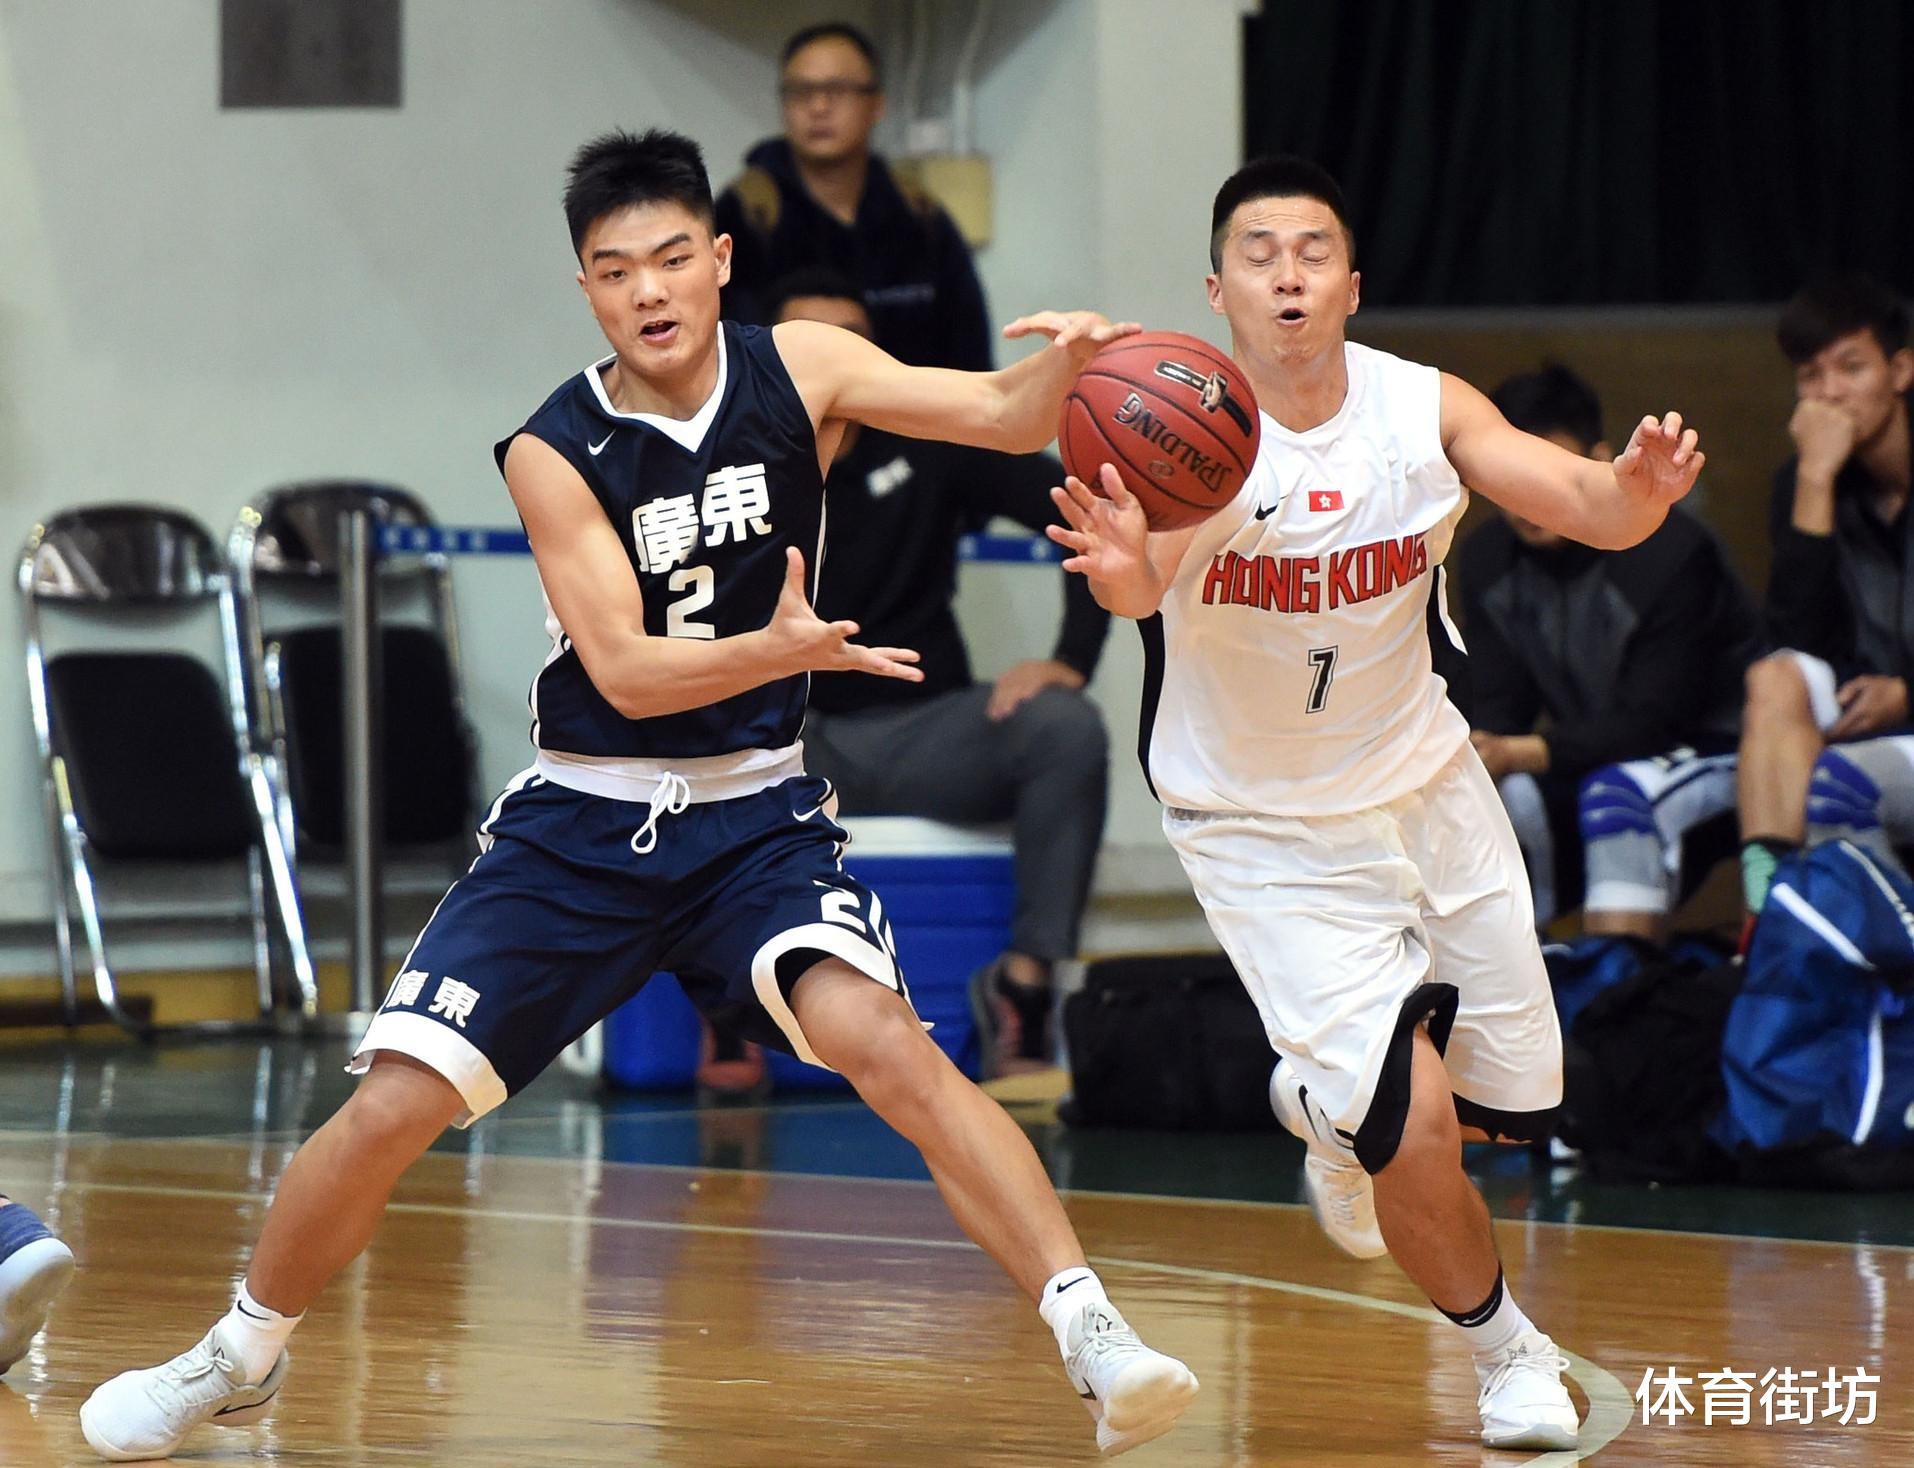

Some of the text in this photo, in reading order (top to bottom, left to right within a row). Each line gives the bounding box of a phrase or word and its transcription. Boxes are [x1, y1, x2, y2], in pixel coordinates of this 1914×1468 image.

[1112, 392, 1233, 493] SPALDING
[632, 463, 773, 575] 廣東
[667, 565, 716, 639] 2
[1202, 532, 1428, 614] HONG KONG
[1305, 645, 1339, 714] 7
